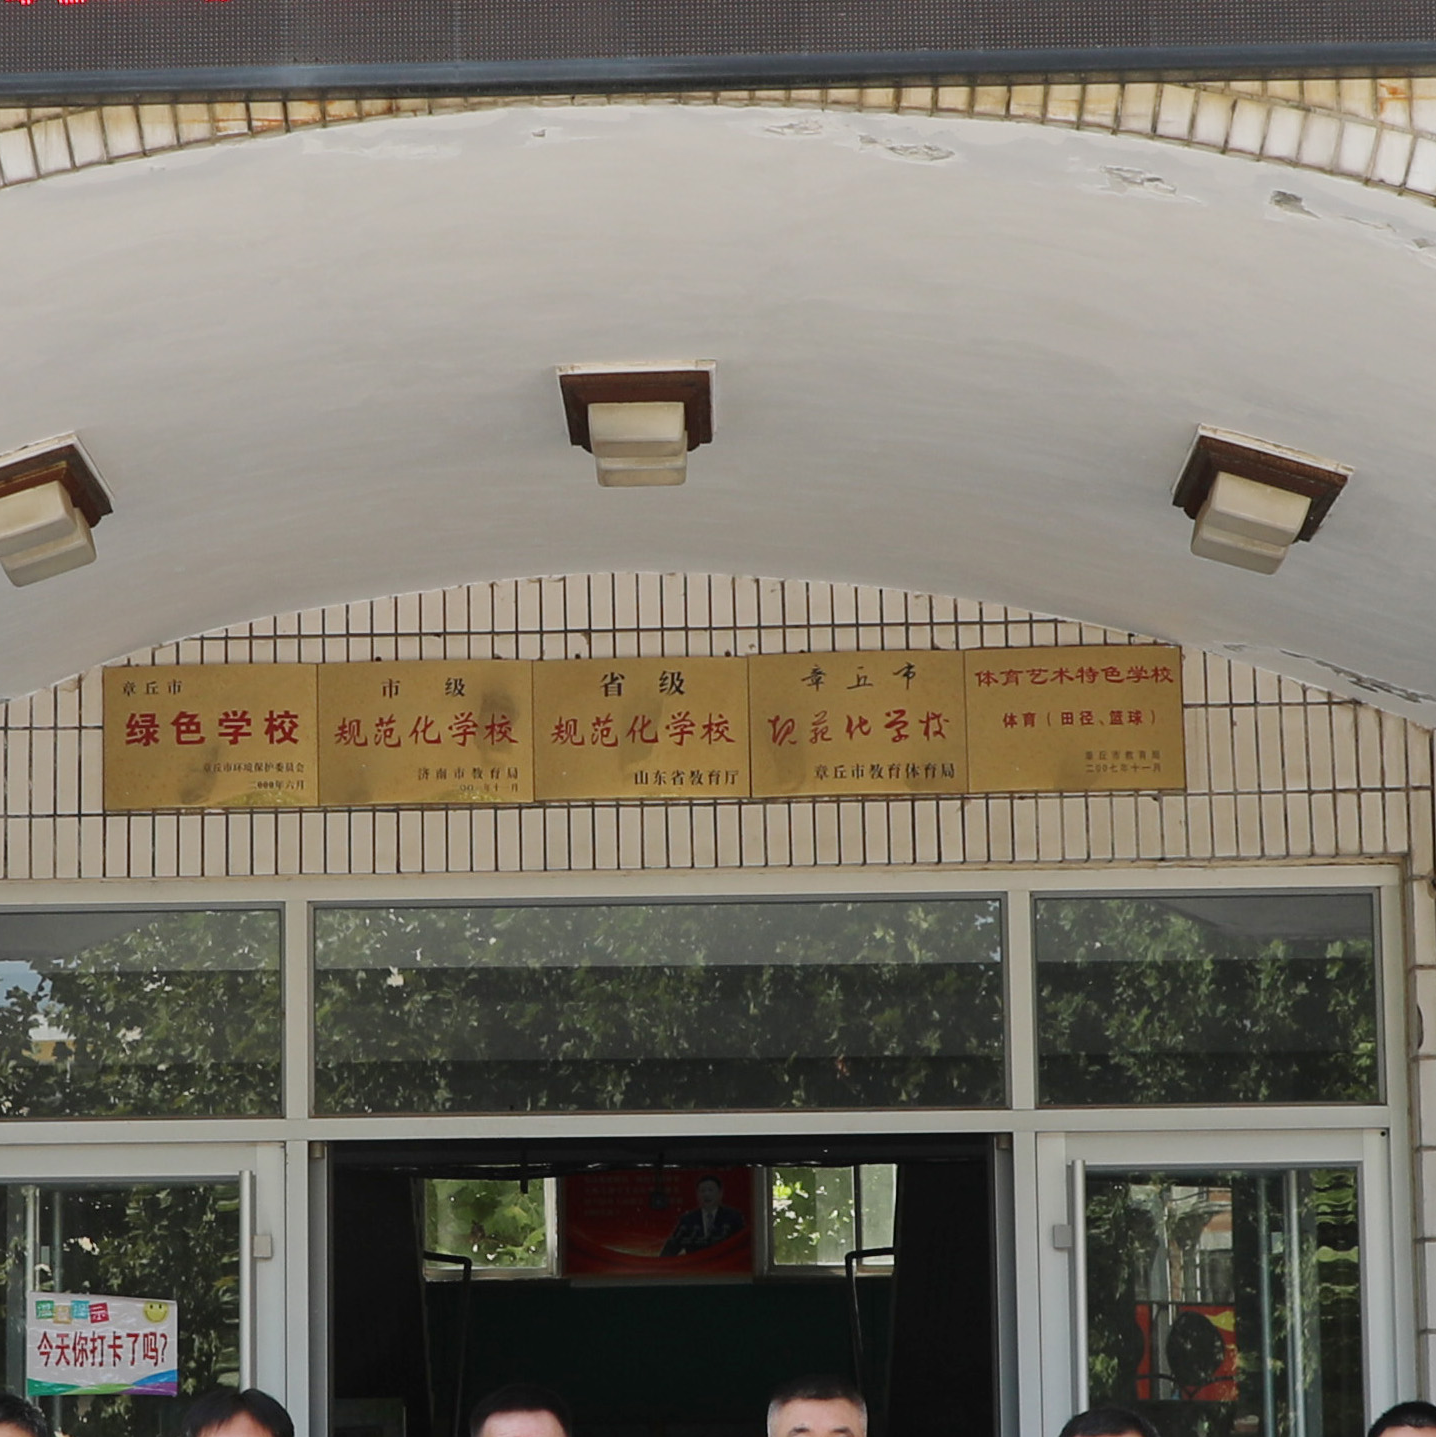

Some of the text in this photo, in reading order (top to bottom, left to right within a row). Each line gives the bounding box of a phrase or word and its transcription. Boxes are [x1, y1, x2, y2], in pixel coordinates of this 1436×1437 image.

[122, 679, 183, 696] 章丘市
[381, 677, 466, 699] 市级
[600, 670, 685, 697] 省级
[801, 661, 916, 692] 章丘市
[975, 666, 1174, 687] 体育艺术特色学校
[124, 709, 300, 747] 绿色学校
[334, 711, 520, 748] 规范化学校
[549, 711, 736, 748] 规范化学校
[767, 708, 951, 747] 规范化学校
[417, 766, 519, 781] 济南市教育局
[633, 769, 739, 786] 山东省教育厅
[814, 762, 955, 781] 章丘市教育体育局
